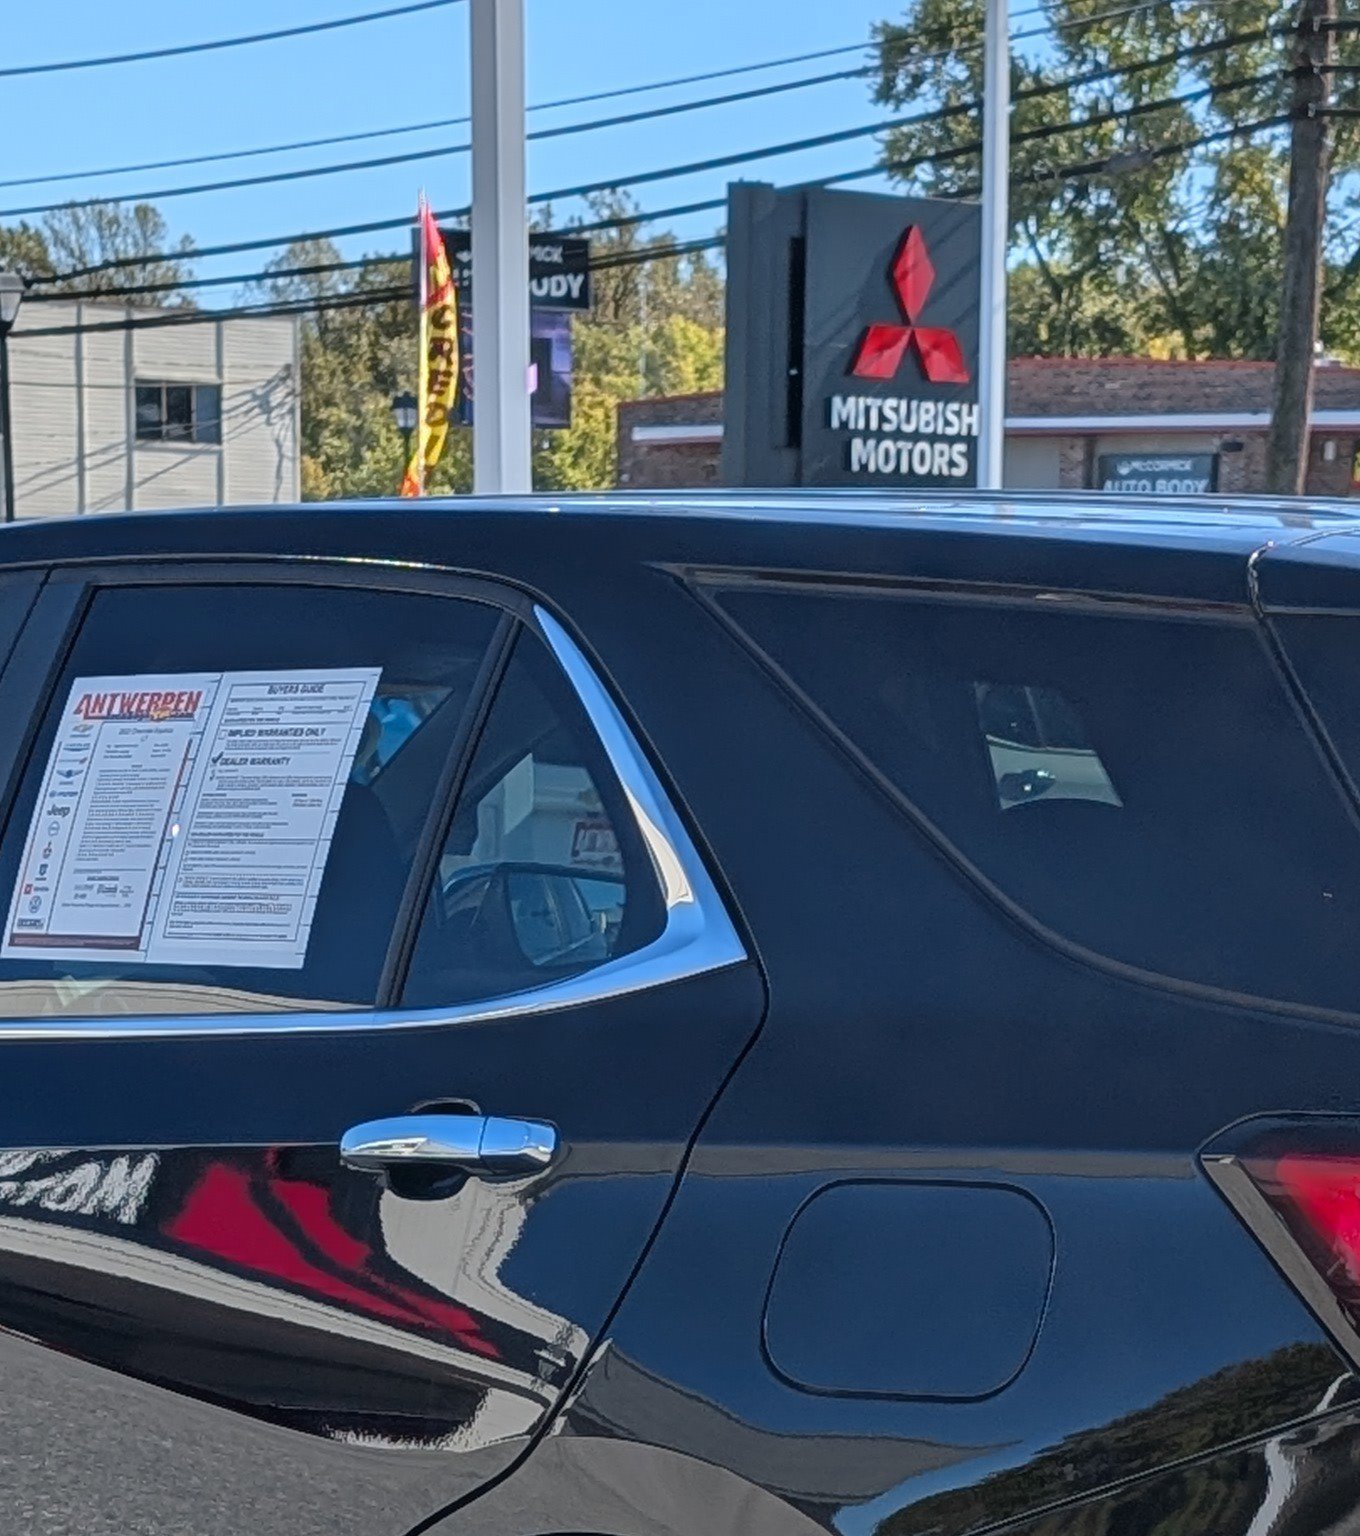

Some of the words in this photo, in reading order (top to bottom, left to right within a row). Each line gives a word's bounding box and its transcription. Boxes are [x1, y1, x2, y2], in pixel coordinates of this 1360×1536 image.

[529, 273, 585, 298] ODY
[830, 395, 979, 436] MITSUBISH
[850, 437, 969, 477] MOTORS
[1103, 479, 1152, 492] AUTO
[1155, 479, 1209, 492] BODY
[73, 690, 203, 716] ANTWERPEN
[47, 804, 71, 818] Jeep
